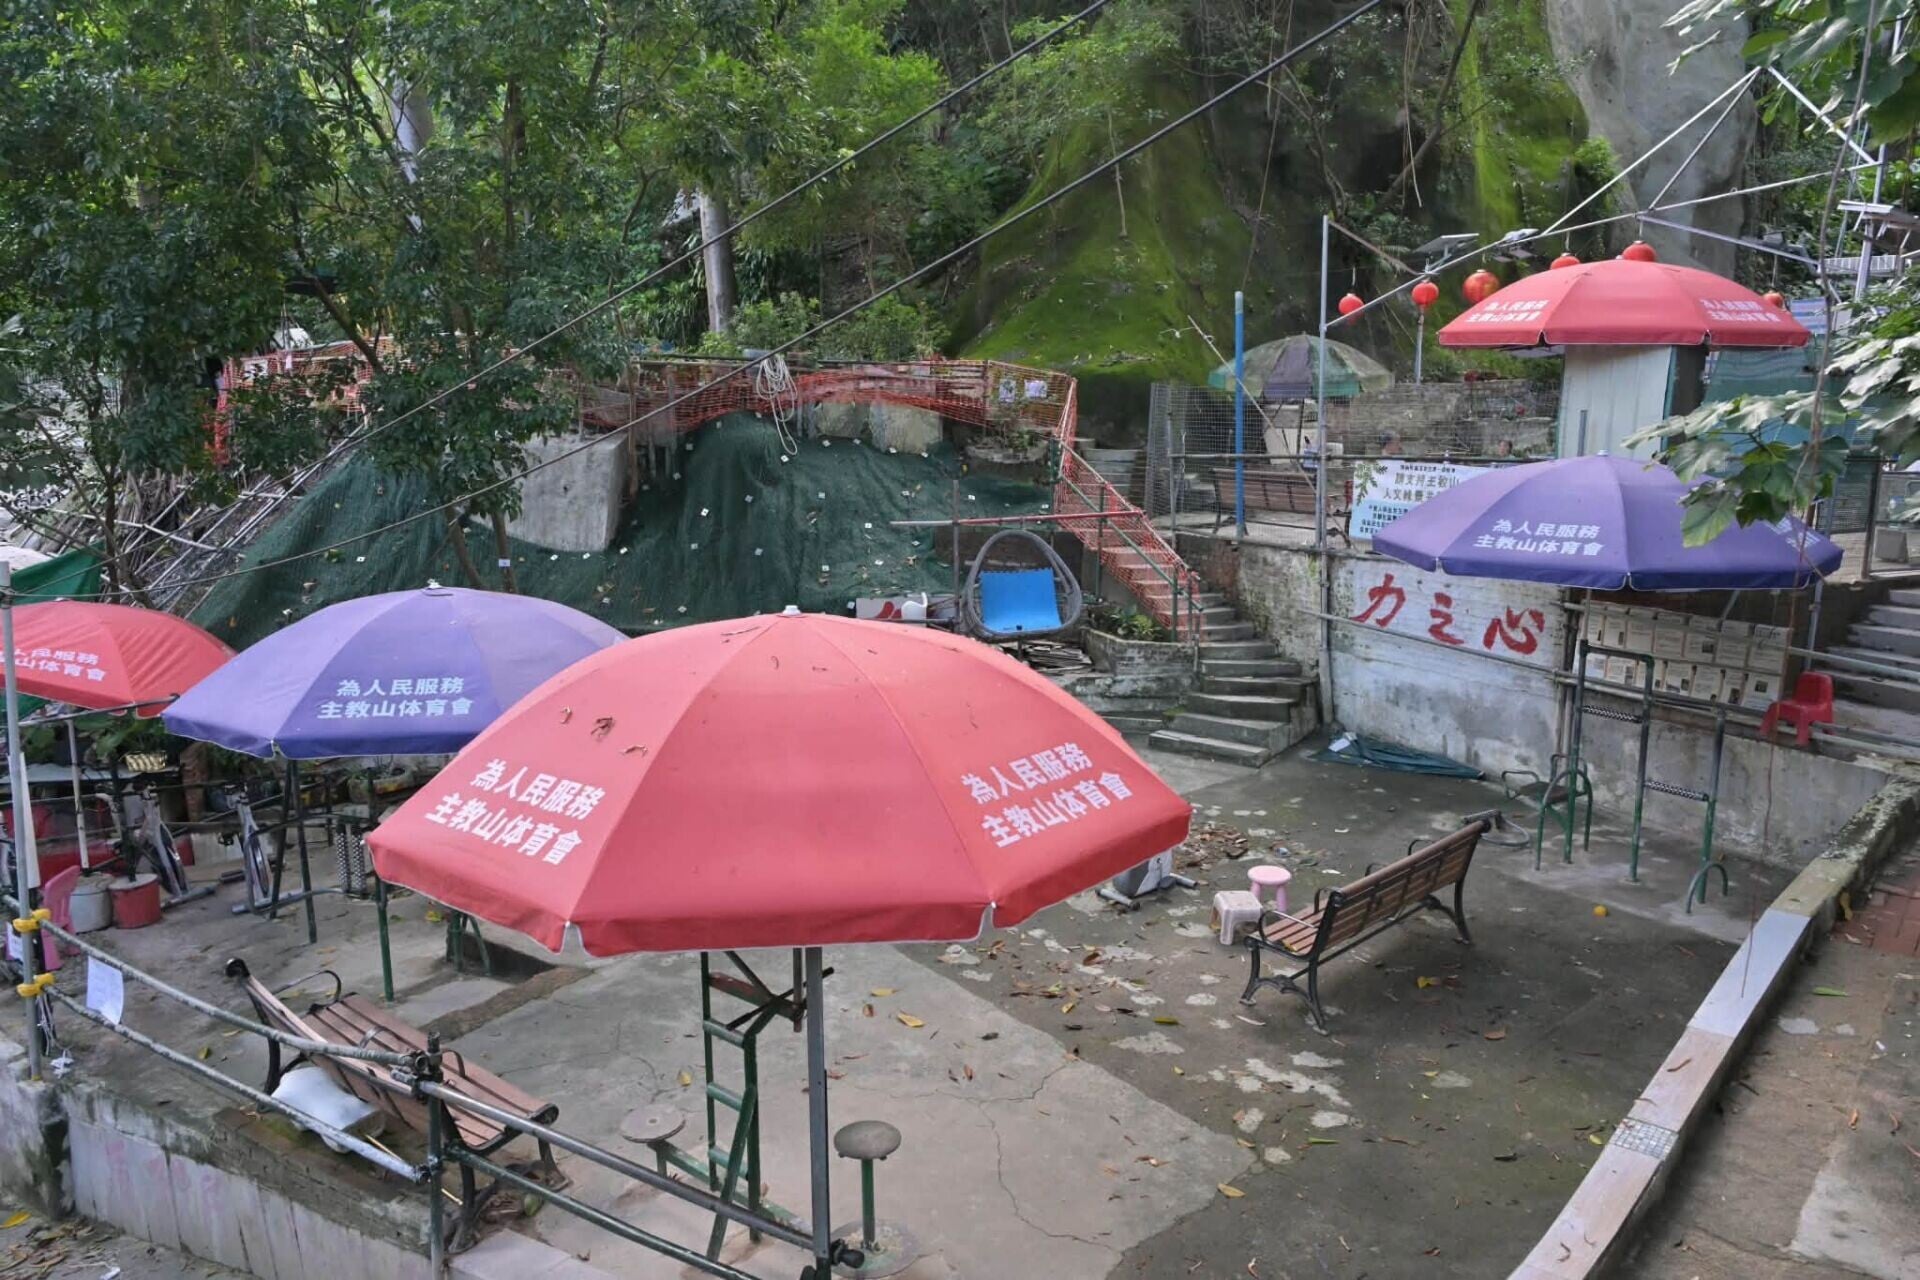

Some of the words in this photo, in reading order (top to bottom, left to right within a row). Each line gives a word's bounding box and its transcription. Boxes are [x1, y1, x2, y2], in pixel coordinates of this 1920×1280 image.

[1473, 534, 1605, 556] 主教山体育會
[1492, 519, 1601, 539] 為人民服務
[1350, 573, 1545, 655] 力之心
[317, 697, 474, 720] 主教山体育會
[337, 677, 465, 697] 為人民服務
[470, 758, 606, 820] 為人民服務
[961, 742, 1093, 805] 為人民服務
[424, 792, 582, 865] 主教山体育會
[981, 771, 1133, 848] 主教山体育會
